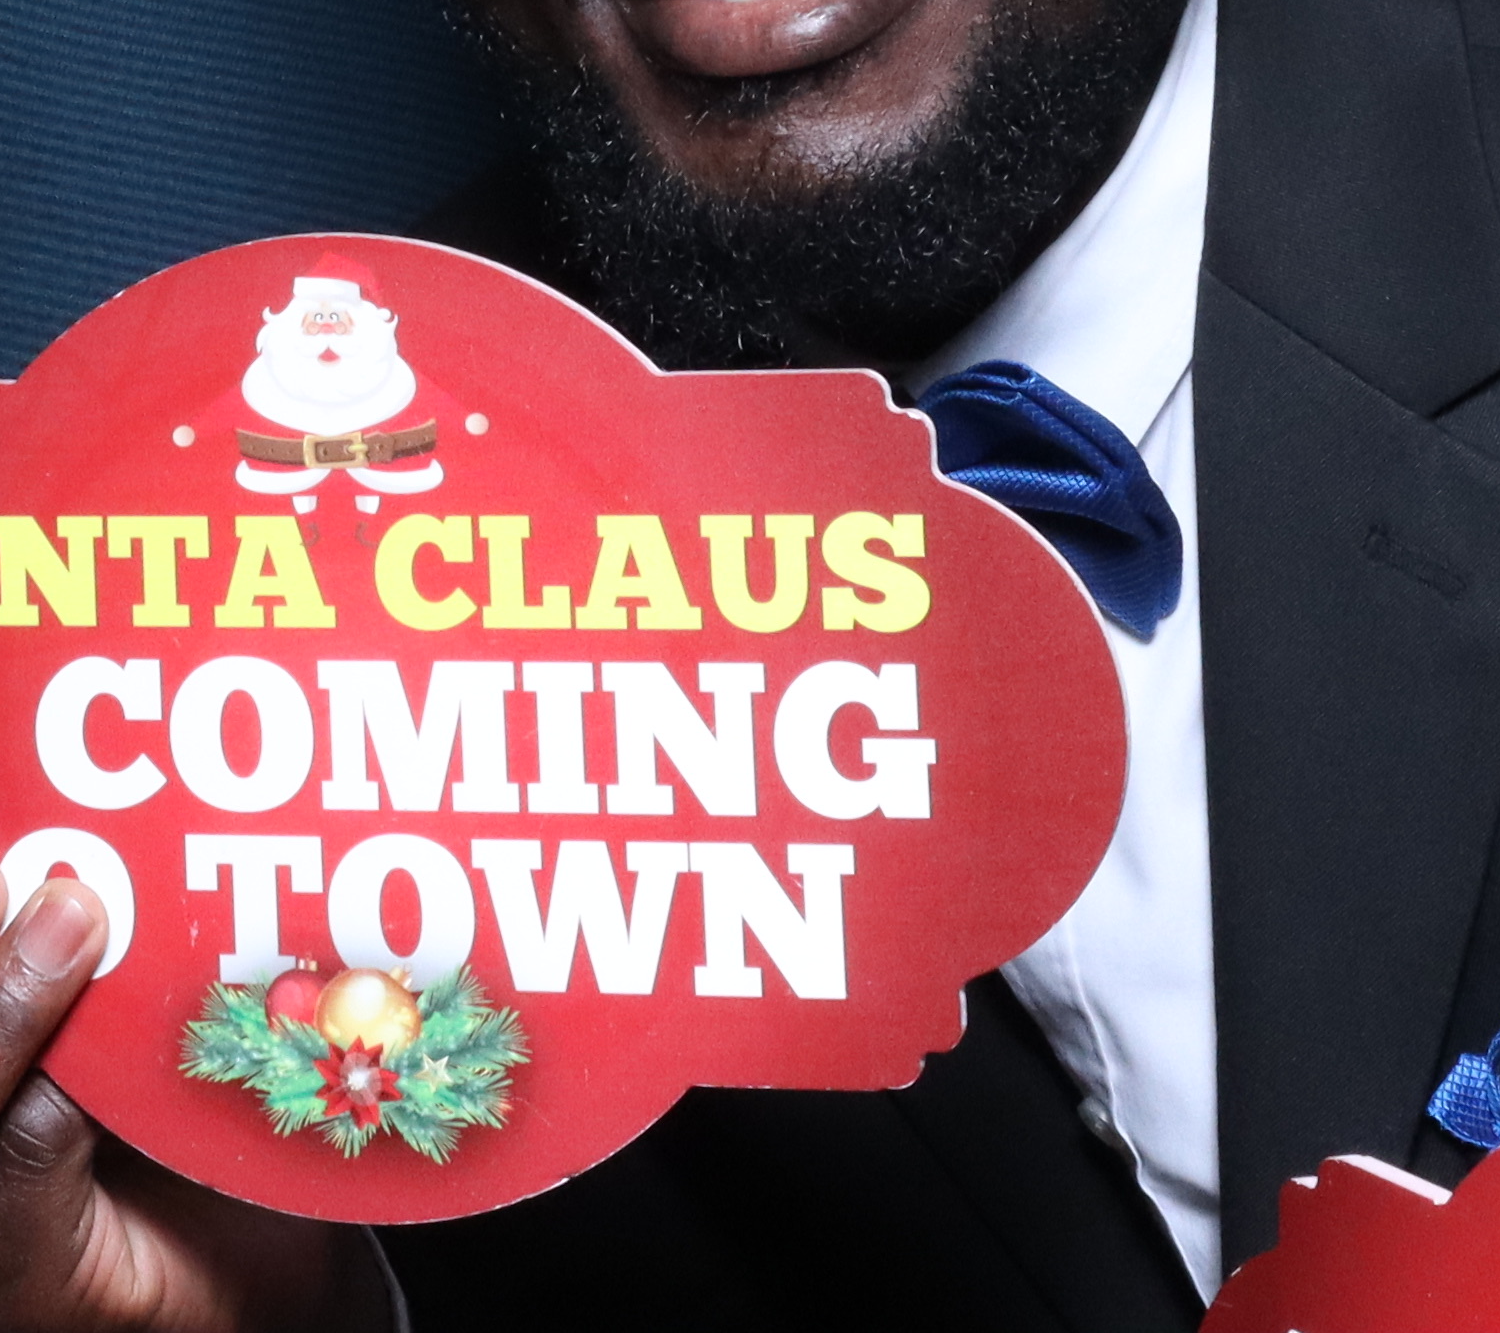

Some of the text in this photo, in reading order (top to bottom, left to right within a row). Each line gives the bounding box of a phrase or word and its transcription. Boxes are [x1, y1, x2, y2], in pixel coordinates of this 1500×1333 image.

[373, 512, 931, 634] CLAUS
[34, 655, 937, 821] COMING
[184, 833, 855, 1001] TOWN
